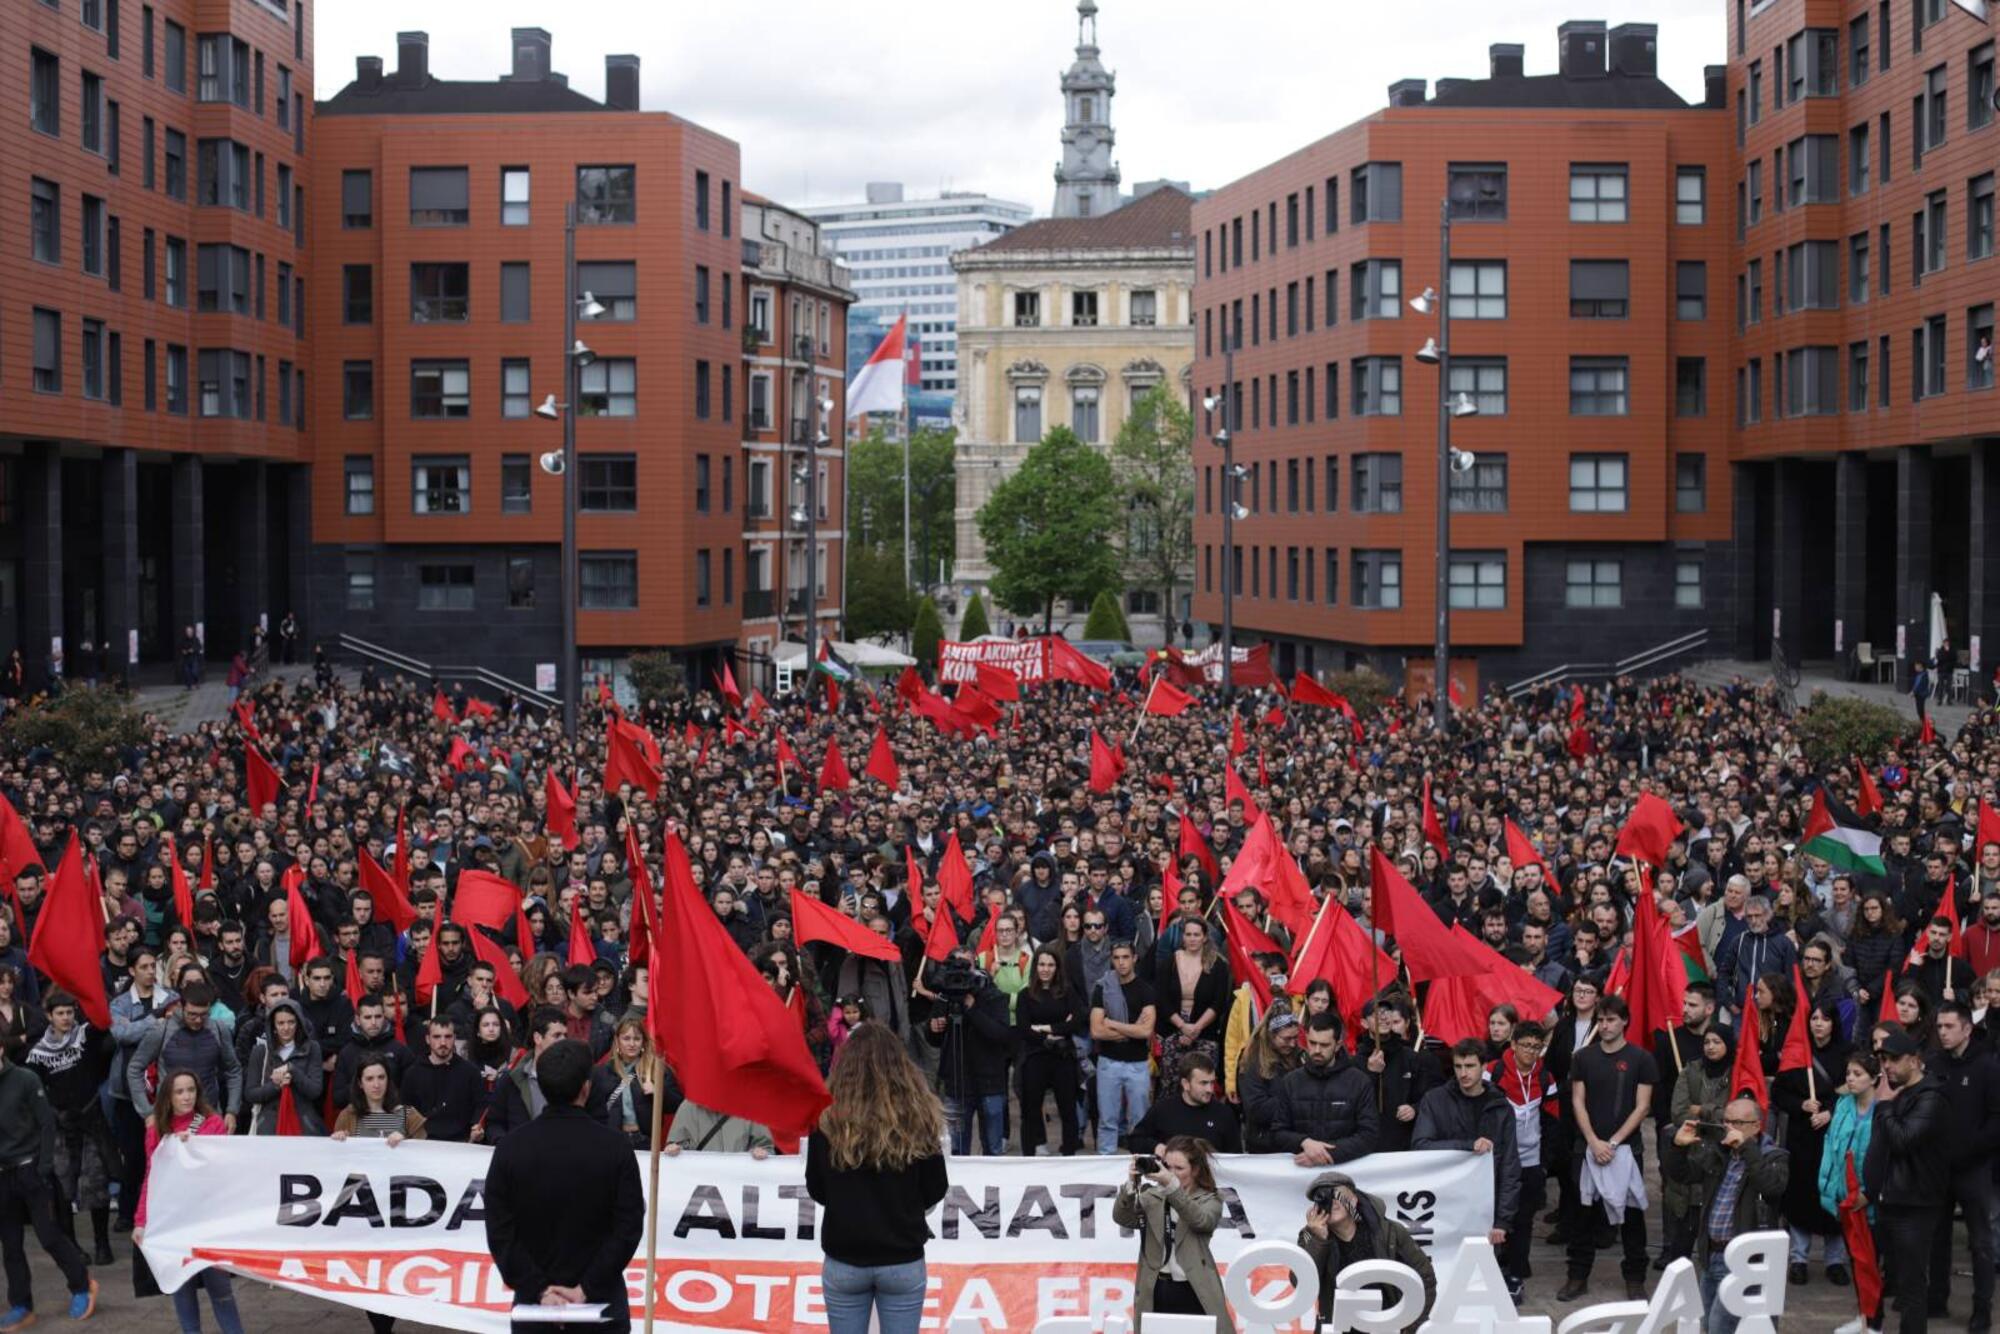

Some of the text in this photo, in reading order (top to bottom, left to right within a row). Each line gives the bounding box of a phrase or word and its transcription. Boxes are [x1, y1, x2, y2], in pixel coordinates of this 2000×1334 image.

[941, 658, 1043, 682] KOMSTA
[277, 1172, 1256, 1240] BADA ALTNATA
